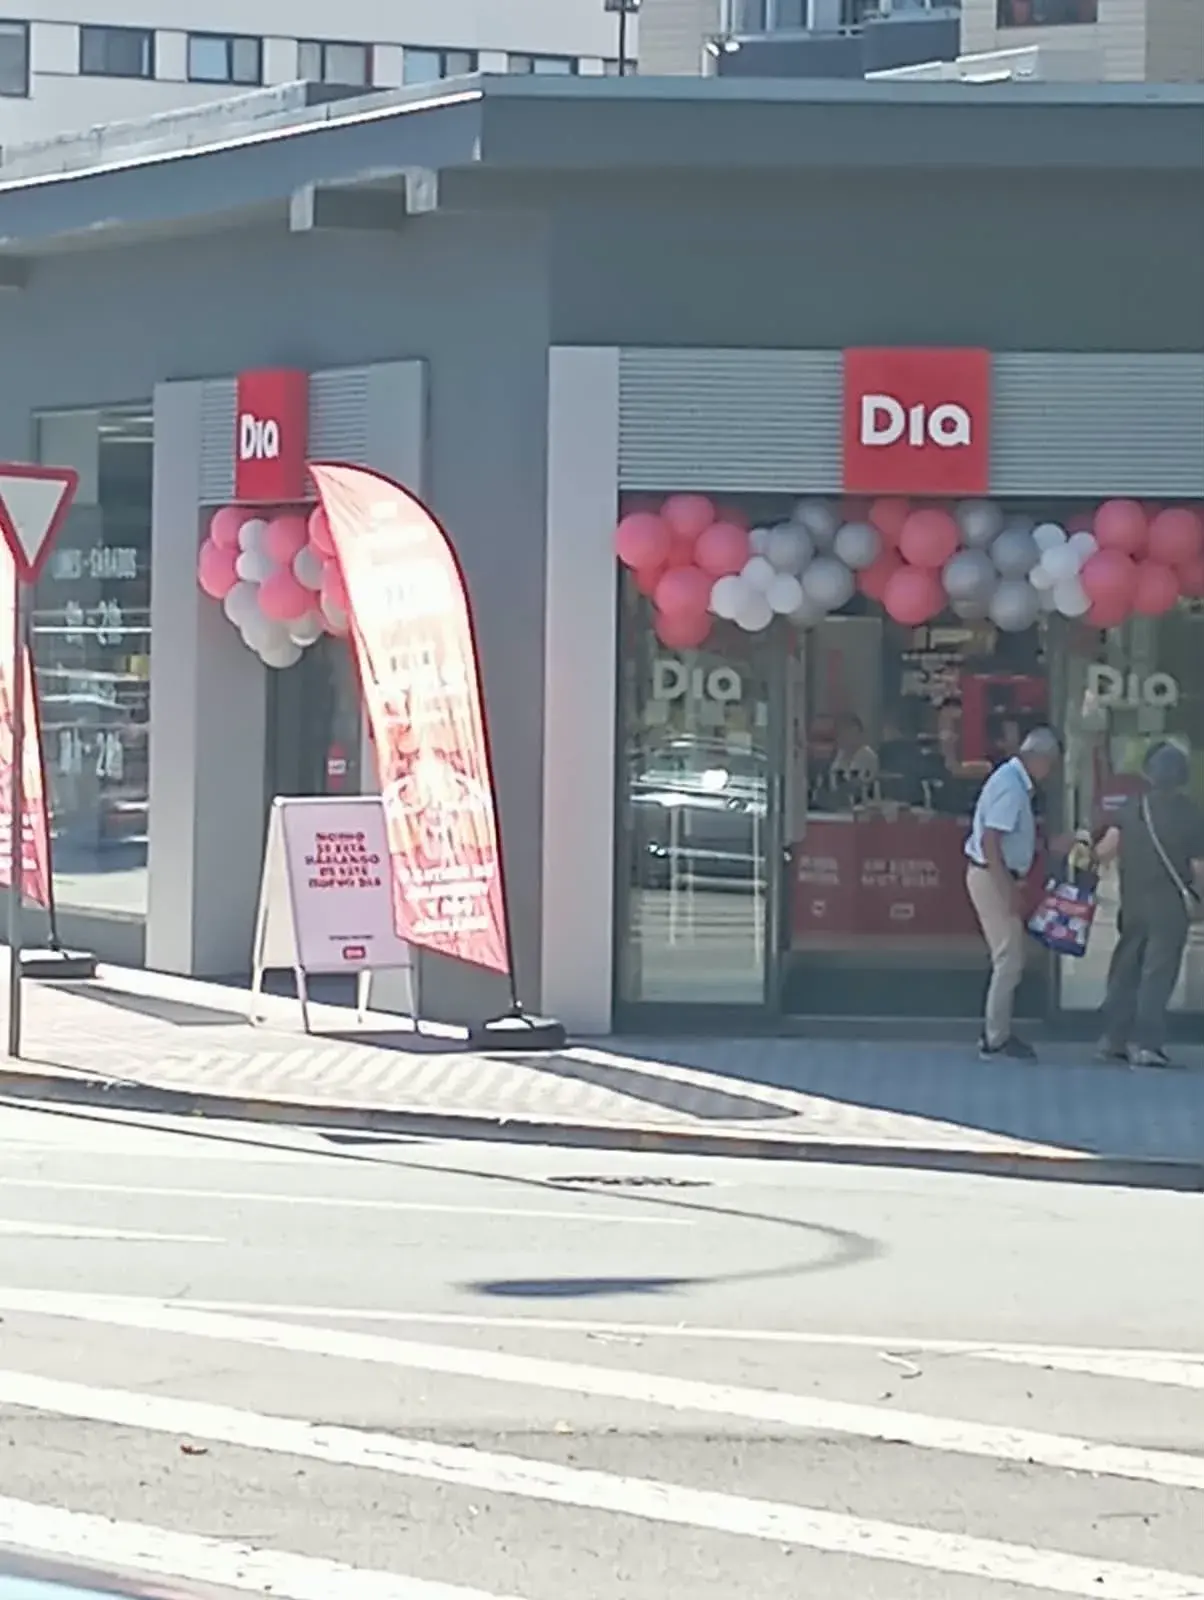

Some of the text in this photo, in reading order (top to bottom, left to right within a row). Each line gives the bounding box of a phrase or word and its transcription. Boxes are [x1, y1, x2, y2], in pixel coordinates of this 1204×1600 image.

[240, 413, 279, 459] Dia
[861, 395, 970, 446] Dia
[652, 660, 742, 702] Dia
[1089, 664, 1178, 707] Dia
